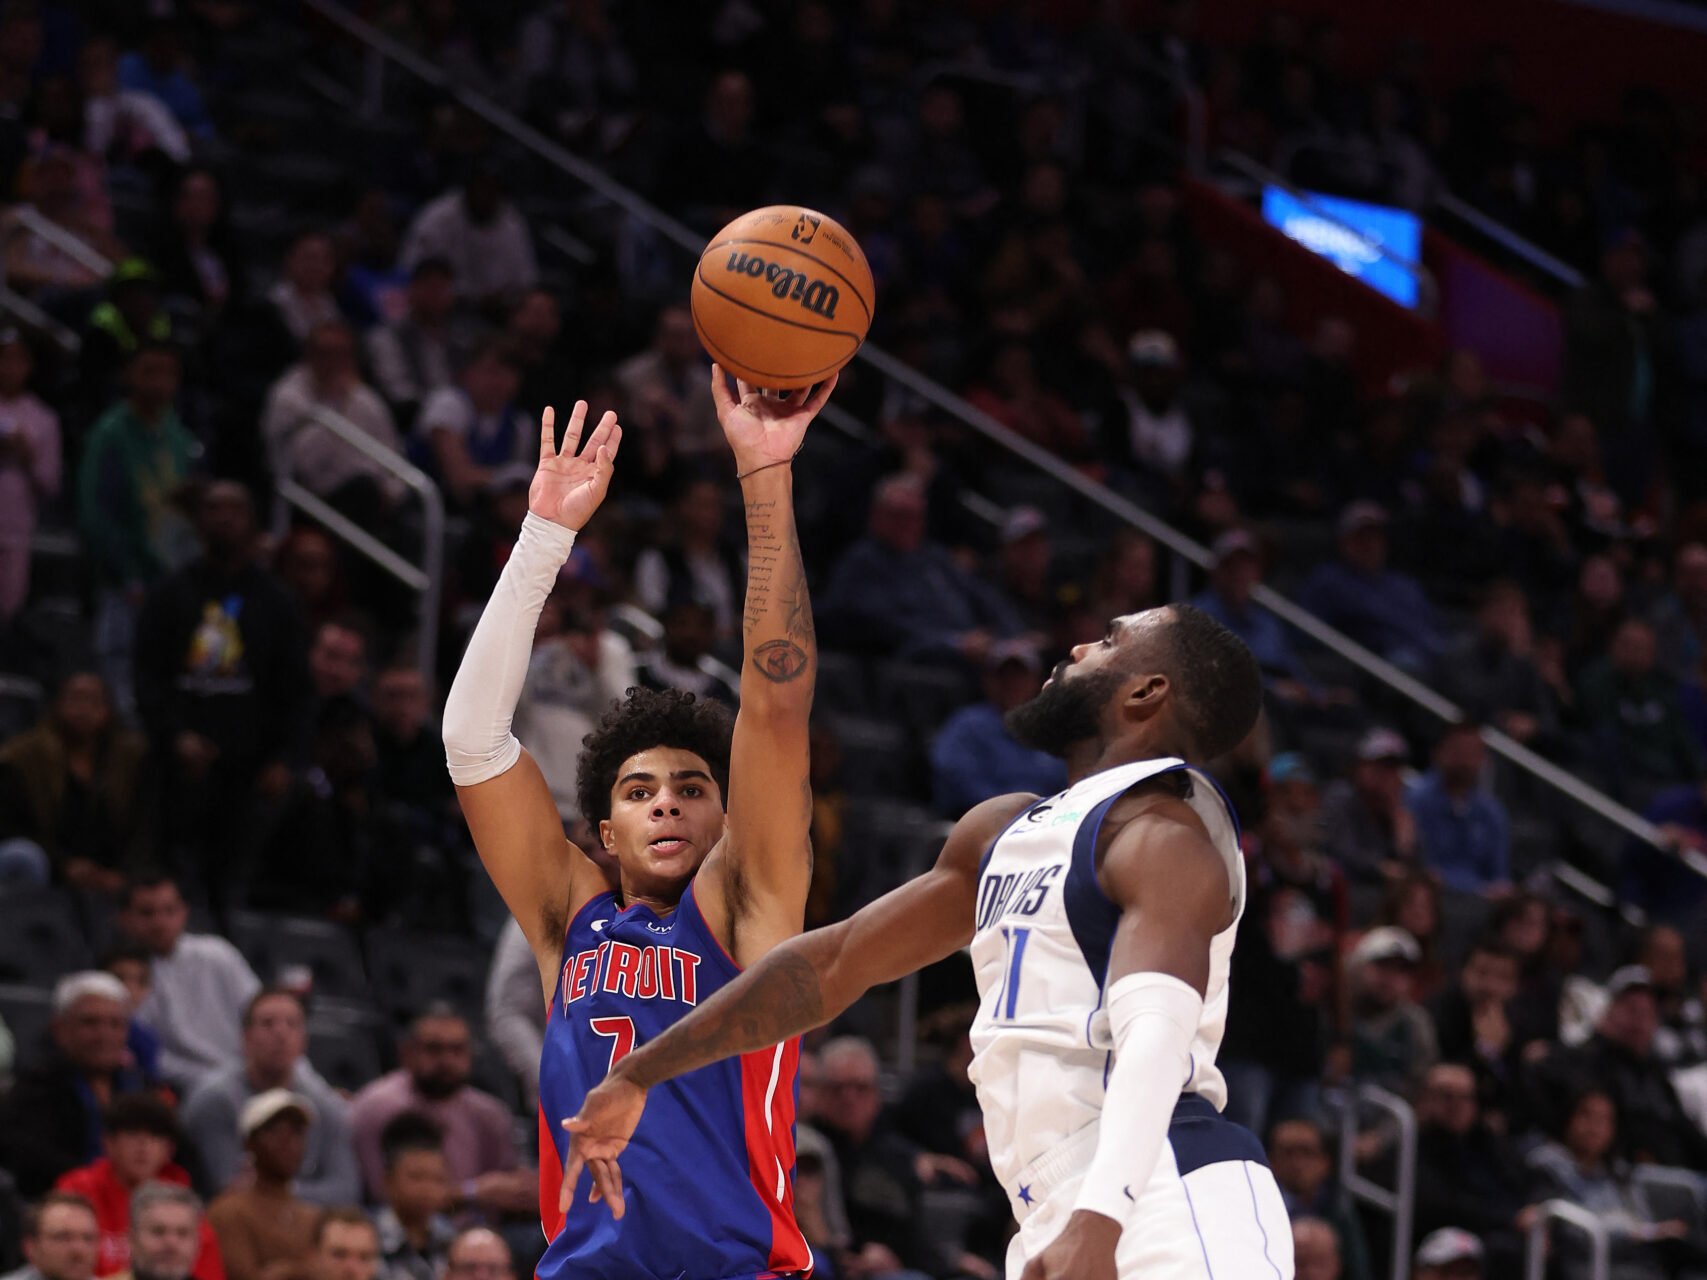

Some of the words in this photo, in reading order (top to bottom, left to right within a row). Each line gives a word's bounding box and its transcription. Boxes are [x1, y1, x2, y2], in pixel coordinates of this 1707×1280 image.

[726, 252, 840, 320] Wilson
[561, 940, 702, 1018] DETROIT
[590, 1015, 636, 1075] 7
